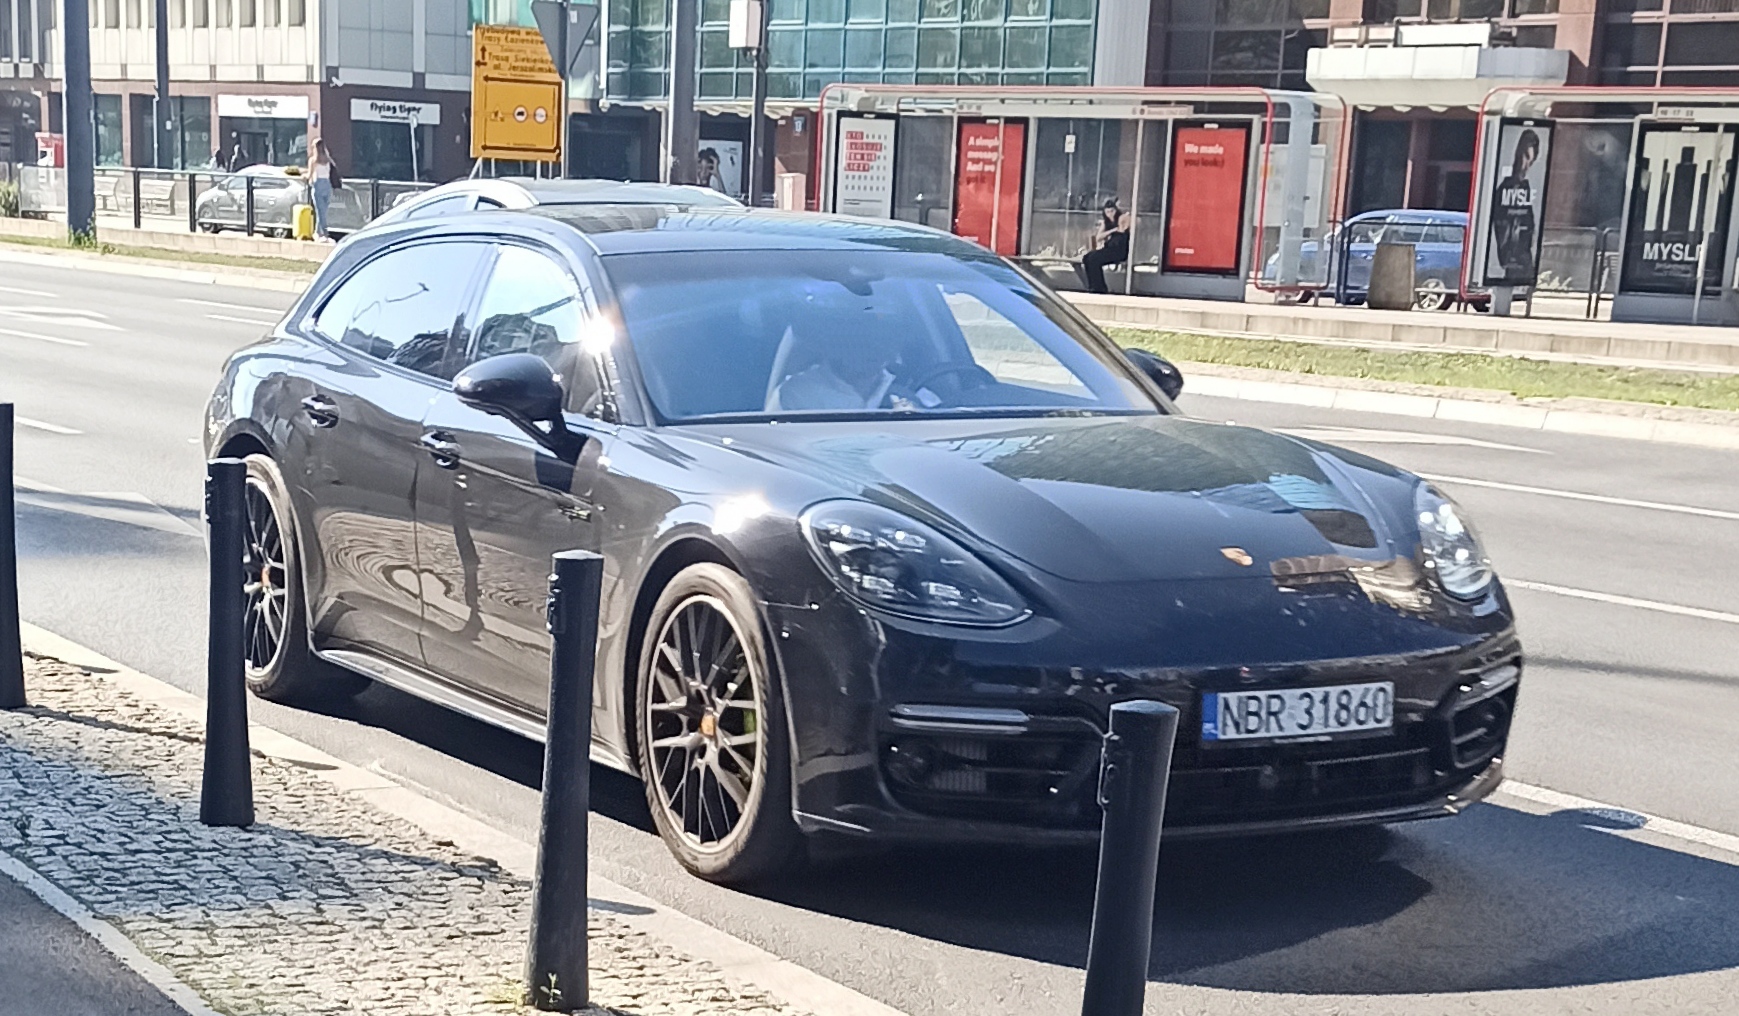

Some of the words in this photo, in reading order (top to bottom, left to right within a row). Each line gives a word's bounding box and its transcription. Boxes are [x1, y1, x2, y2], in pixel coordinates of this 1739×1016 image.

[370, 102, 397, 115] flying
[399, 104, 422, 116] tiger
[968, 136, 975, 146] A
[1184, 143, 1199, 154] We
[1199, 143, 1224, 155] made
[966, 161, 983, 172] And
[1184, 158, 1200, 168] you
[1501, 188, 1537, 207] MYSLF
[1221, 693, 1286, 736] NBR
[1295, 686, 1390, 731] 31860
